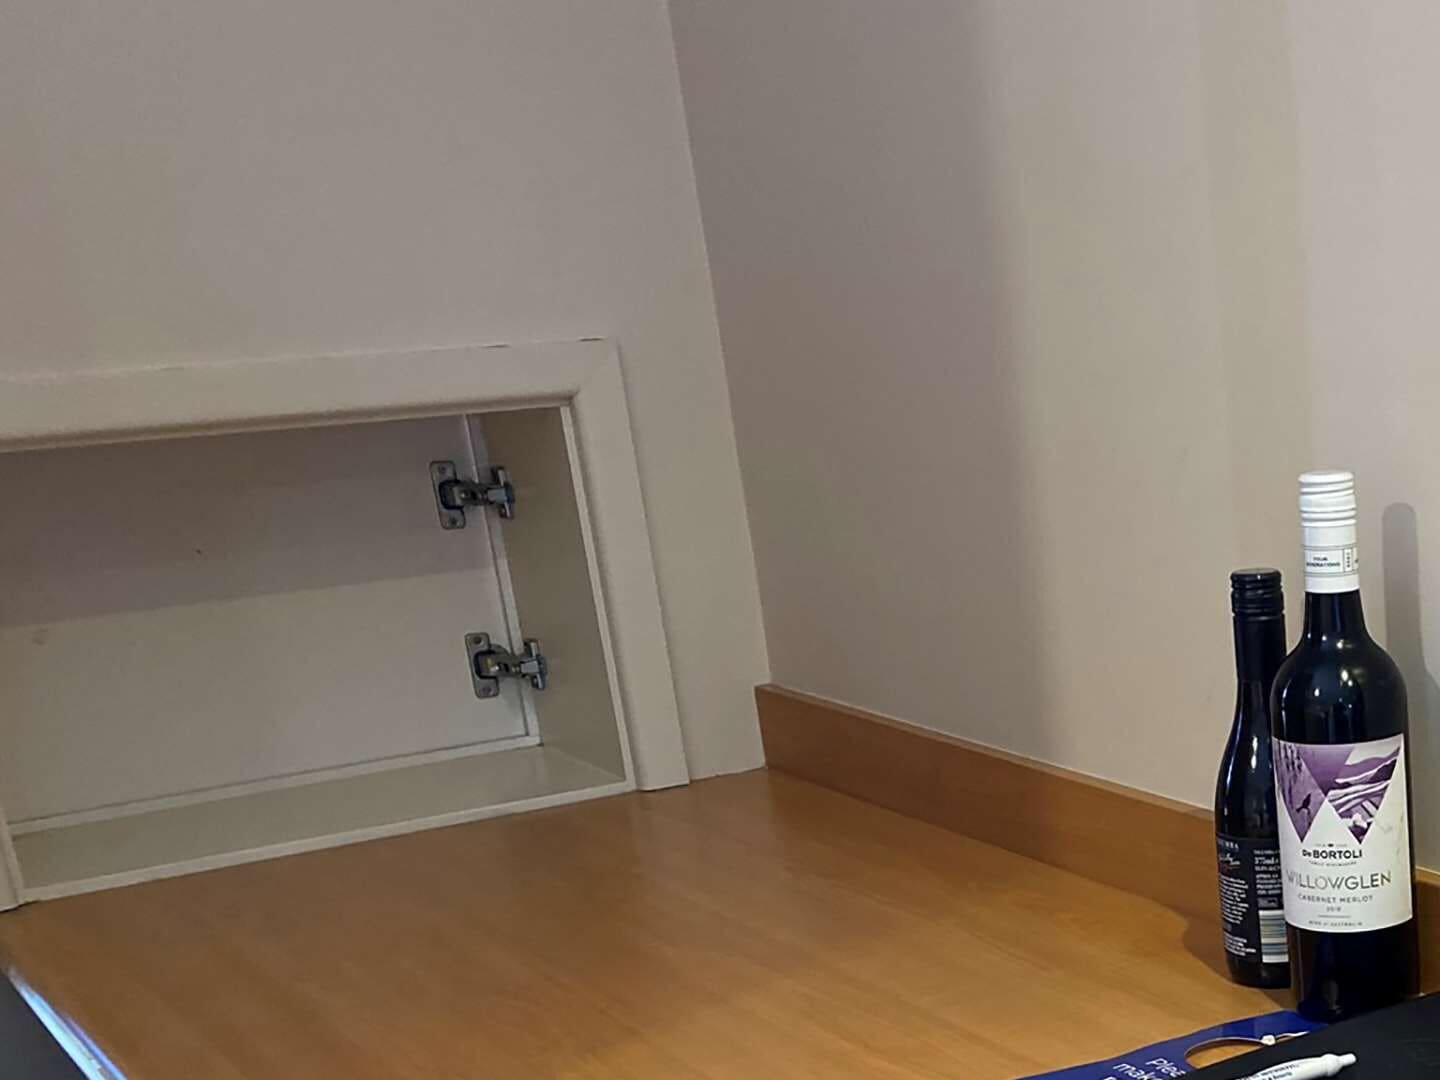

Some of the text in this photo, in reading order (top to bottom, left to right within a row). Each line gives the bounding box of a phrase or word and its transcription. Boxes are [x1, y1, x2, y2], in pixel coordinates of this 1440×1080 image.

[1313, 849, 1362, 859] BORTOLI
[1286, 870, 1391, 891] WILLOWGLEN
[1298, 894, 1373, 904] CABERNET MERLOT
